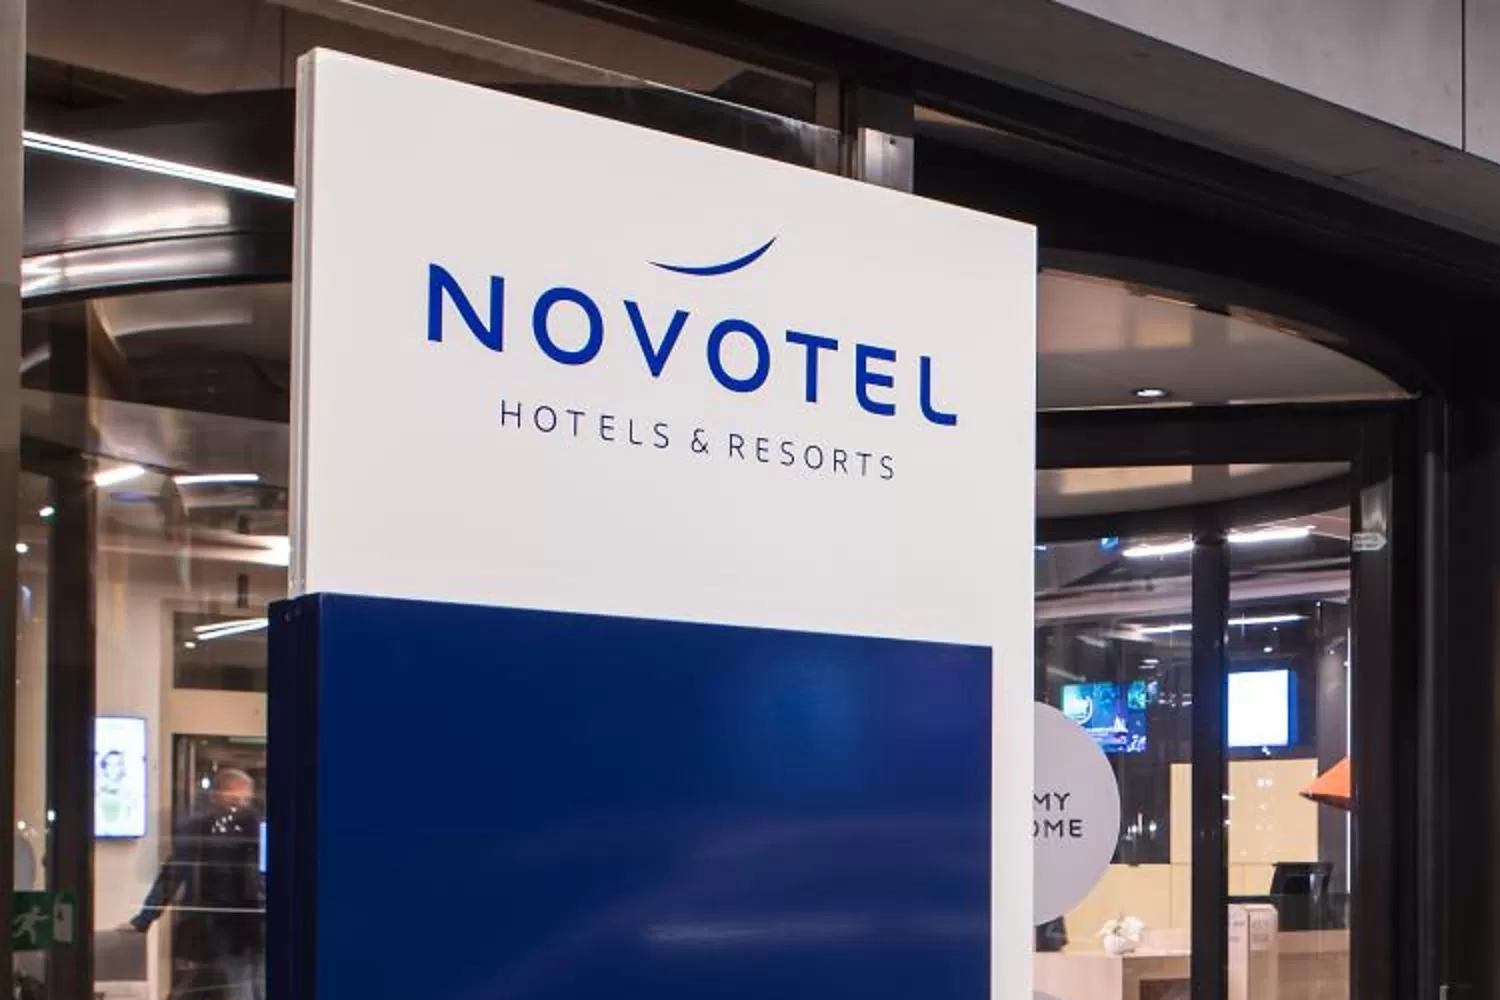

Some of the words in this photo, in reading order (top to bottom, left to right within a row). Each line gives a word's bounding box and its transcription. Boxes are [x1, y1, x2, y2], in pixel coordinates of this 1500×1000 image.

[427, 263, 957, 427] NOVOTEL
[500, 399, 670, 449] HOTELS
[691, 428, 709, 454] &
[729, 433, 895, 481] RESORTS
